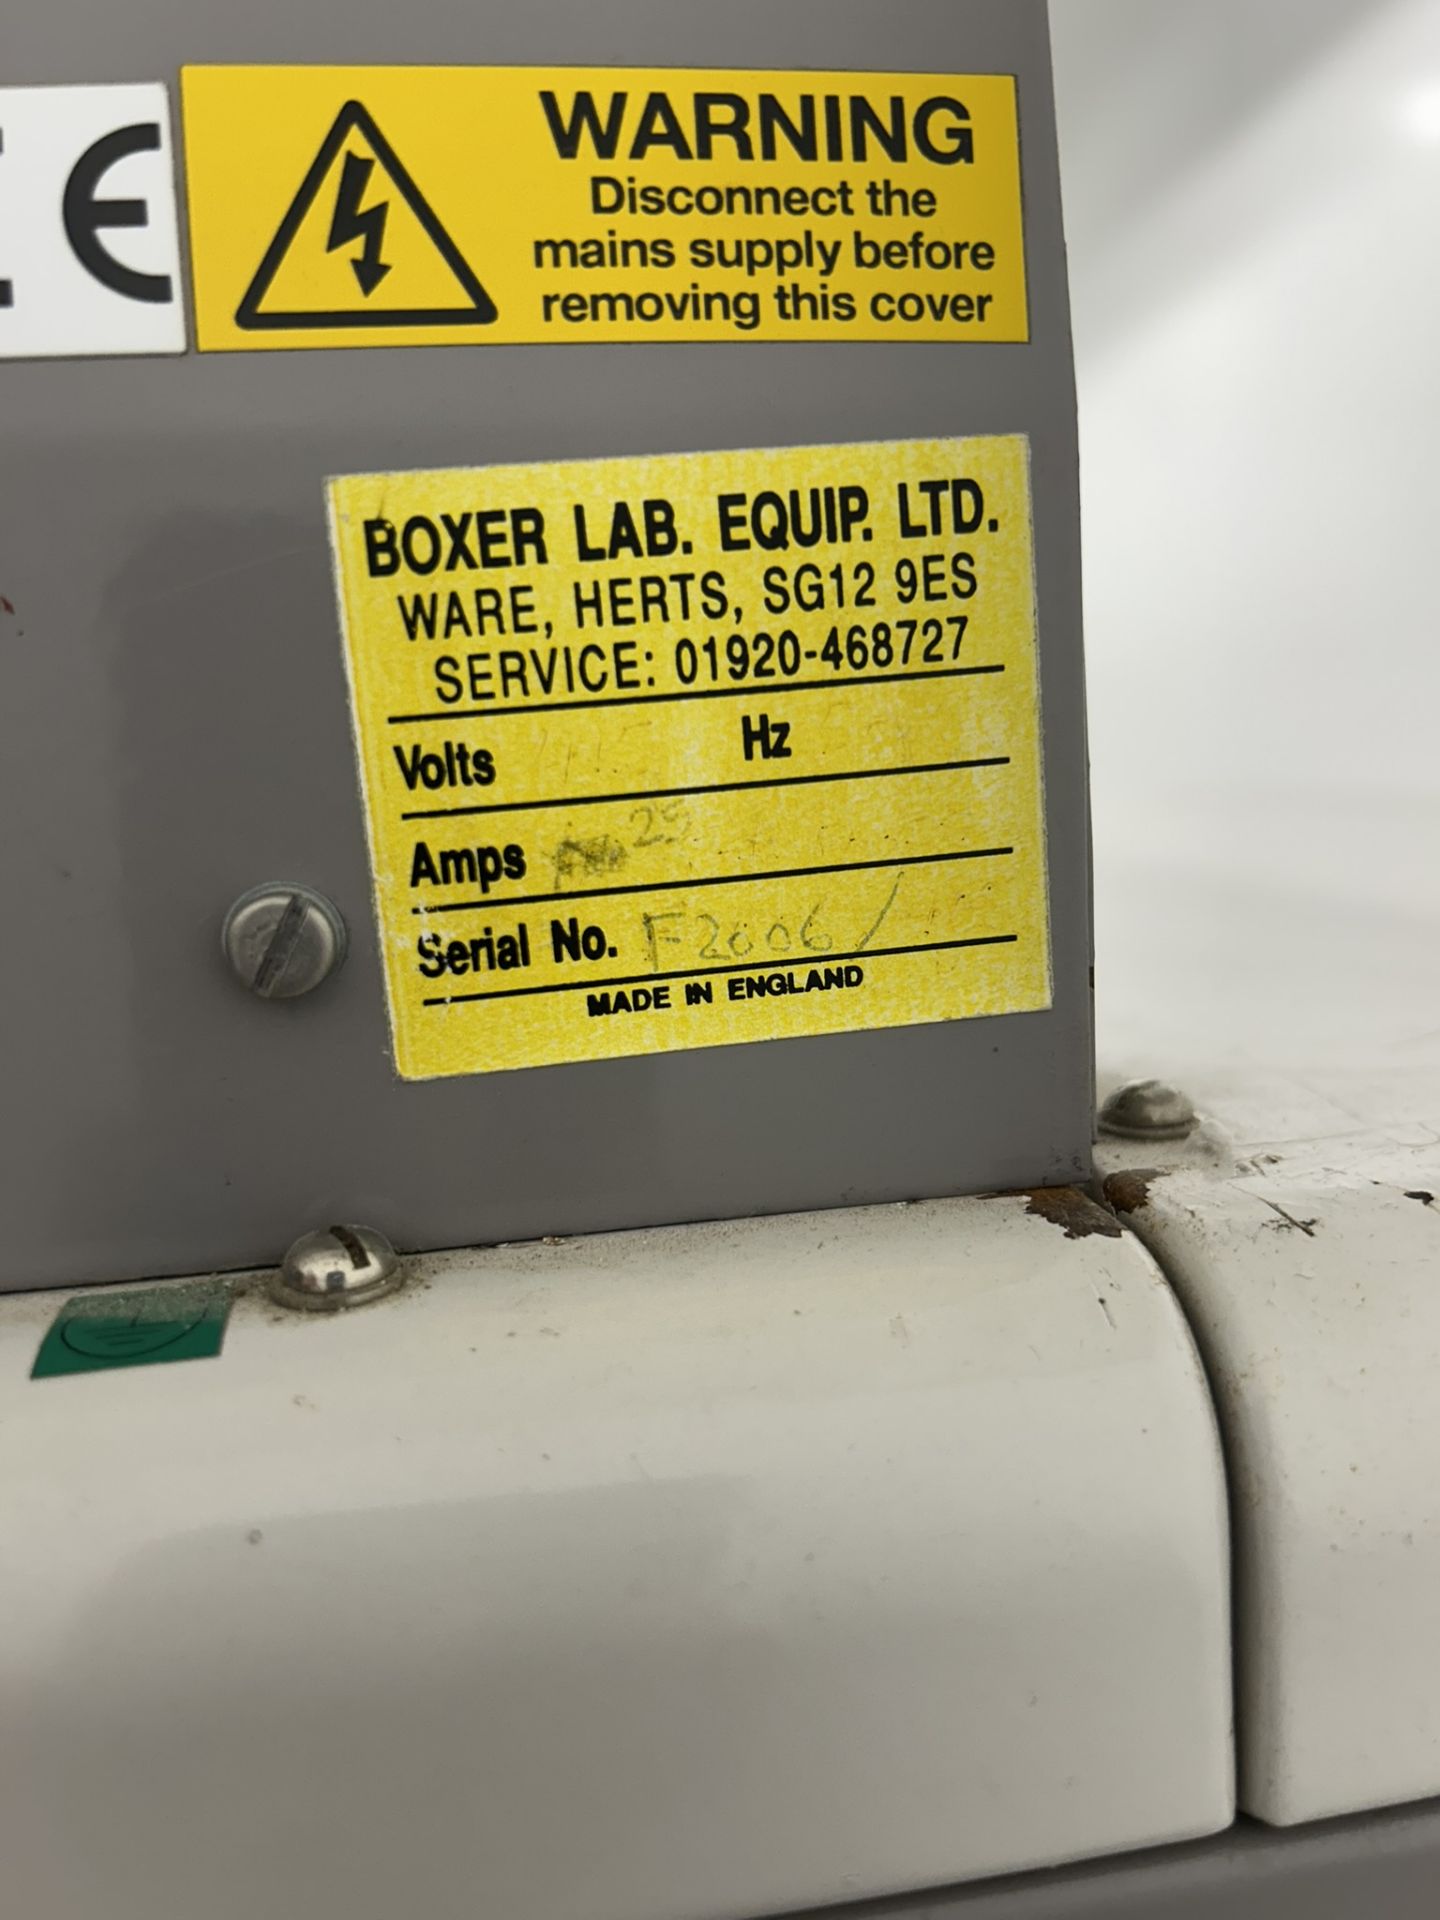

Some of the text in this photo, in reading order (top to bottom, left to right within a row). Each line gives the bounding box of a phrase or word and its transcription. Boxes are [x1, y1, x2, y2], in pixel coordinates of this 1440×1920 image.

[540, 91, 974, 165] WARNING
[592, 177, 935, 217] Disconnect the
[534, 229, 995, 277] mains supply before
[542, 283, 993, 330] removing this cover
[364, 479, 999, 577] BOXER LAB. EQUIP. LTD.
[398, 551, 978, 641] WARE, HERTS, SG12 9ES
[434, 616, 969, 704] SERVICE: 01920-468727
[392, 740, 496, 792] Volts
[741, 714, 793, 761] Hz
[411, 841, 526, 896] Amps
[417, 917, 618, 978] Serial No.
[586, 965, 864, 1018] MADE IN ENGLAND
